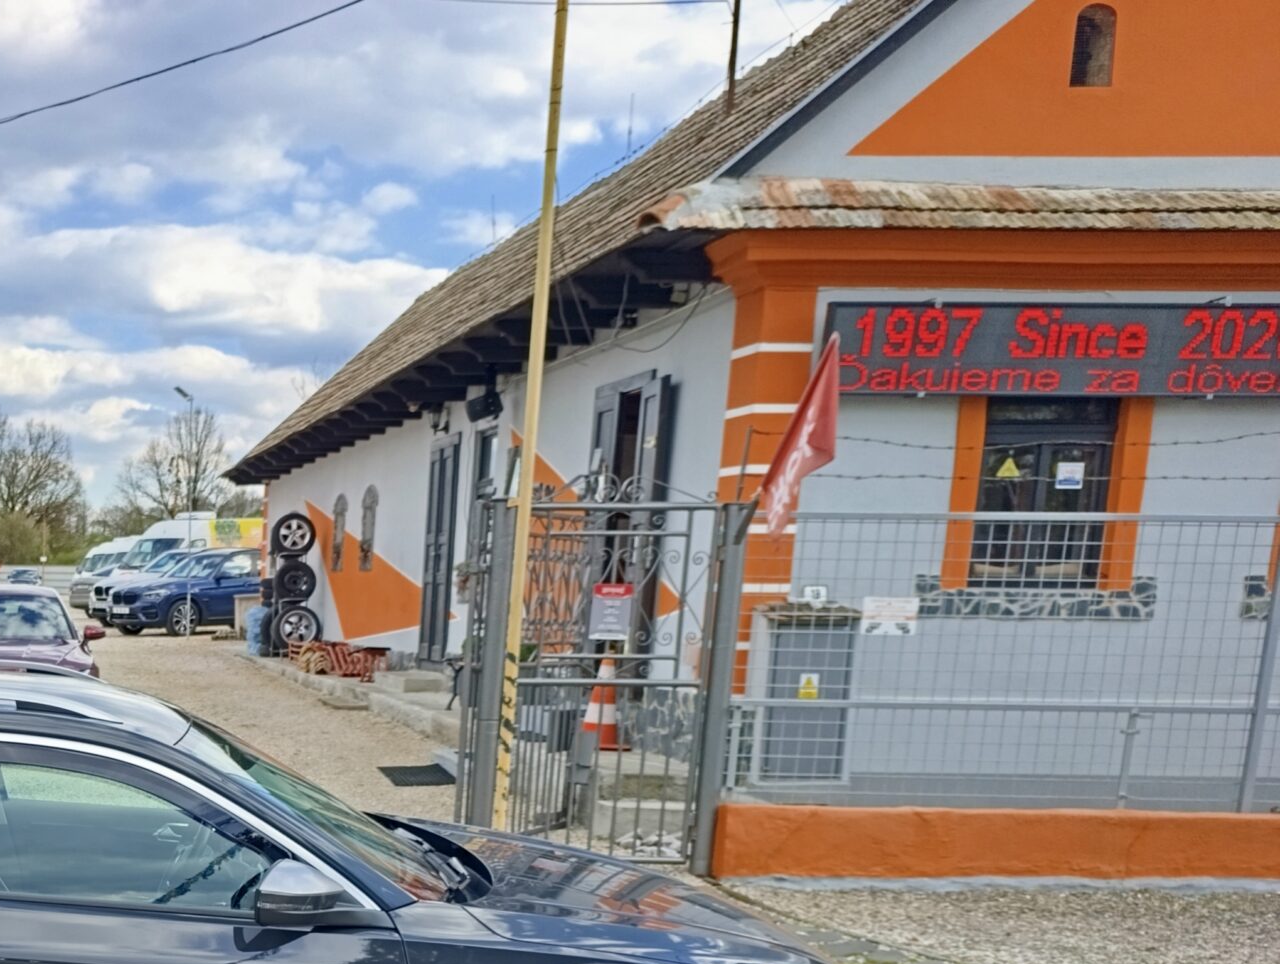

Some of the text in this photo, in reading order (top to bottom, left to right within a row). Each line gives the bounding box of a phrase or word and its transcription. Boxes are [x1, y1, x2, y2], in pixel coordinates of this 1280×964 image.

[854, 307, 1280, 359] 1997 Since 202
[1083, 368, 1141, 393] za
[1167, 363, 1280, 393] dôve
